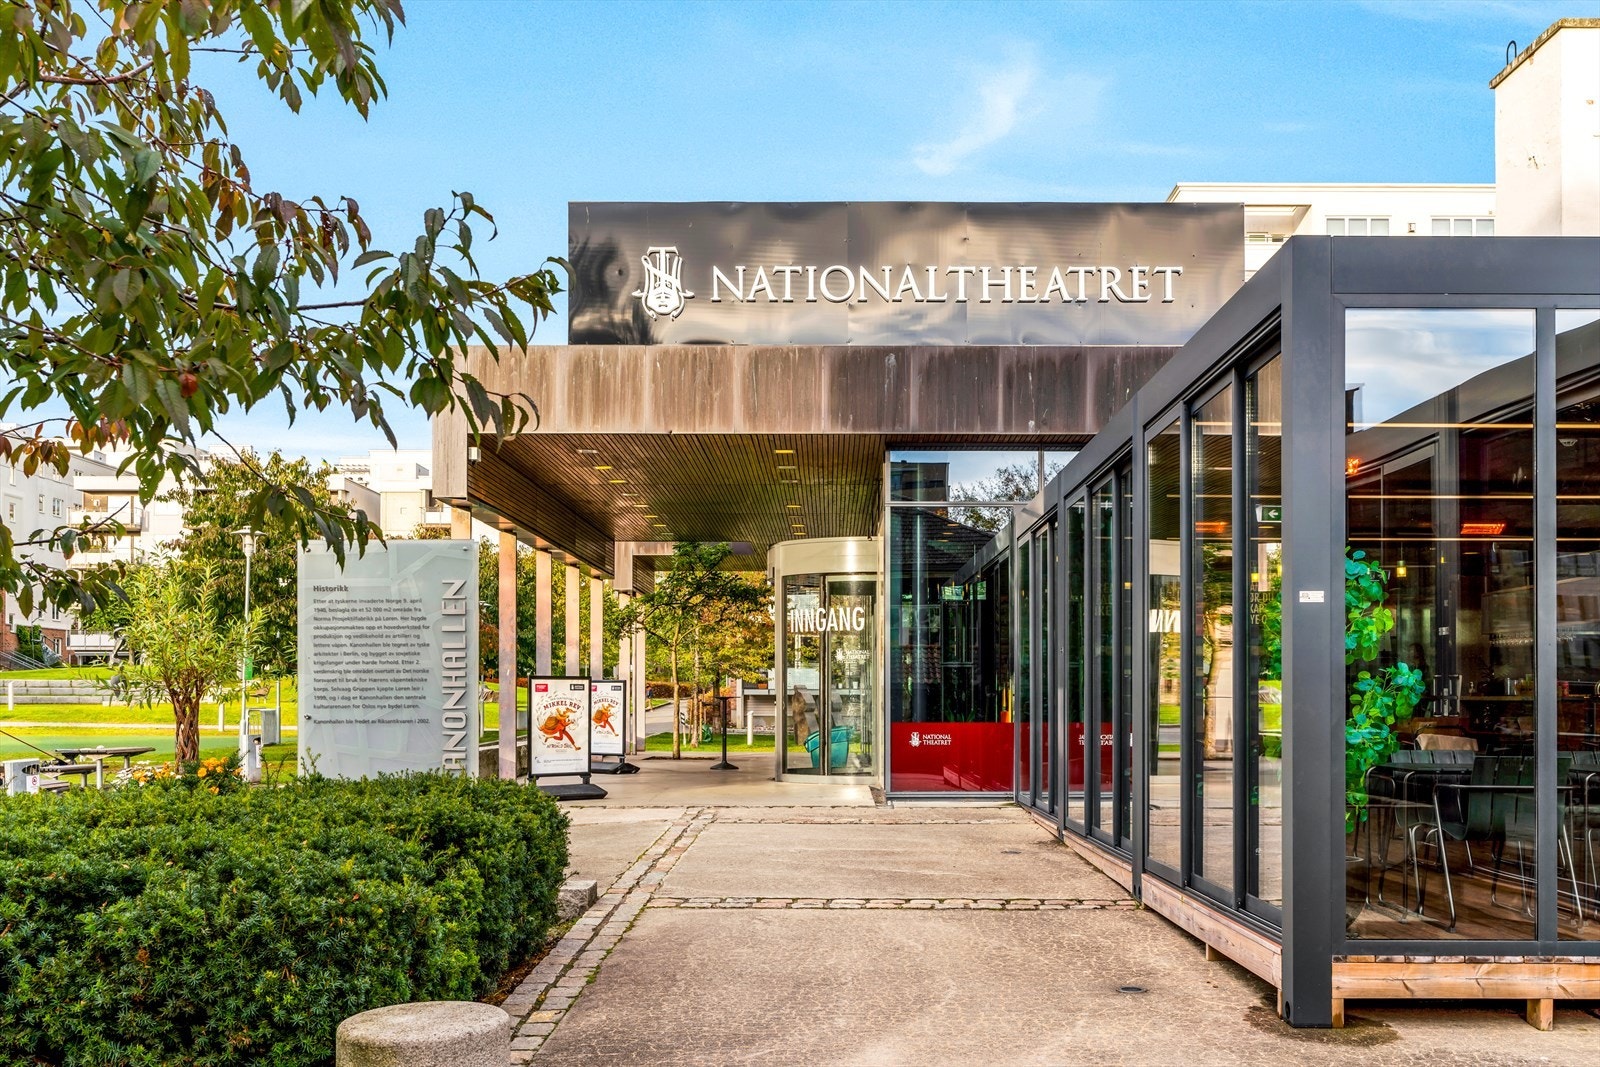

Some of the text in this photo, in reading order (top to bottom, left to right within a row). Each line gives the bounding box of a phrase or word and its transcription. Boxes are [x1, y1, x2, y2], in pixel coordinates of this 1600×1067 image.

[711, 264, 1184, 304] NATIONALTHEATRET
[790, 606, 865, 632] INNGANG
[441, 579, 466, 773] ANONHALLEN
